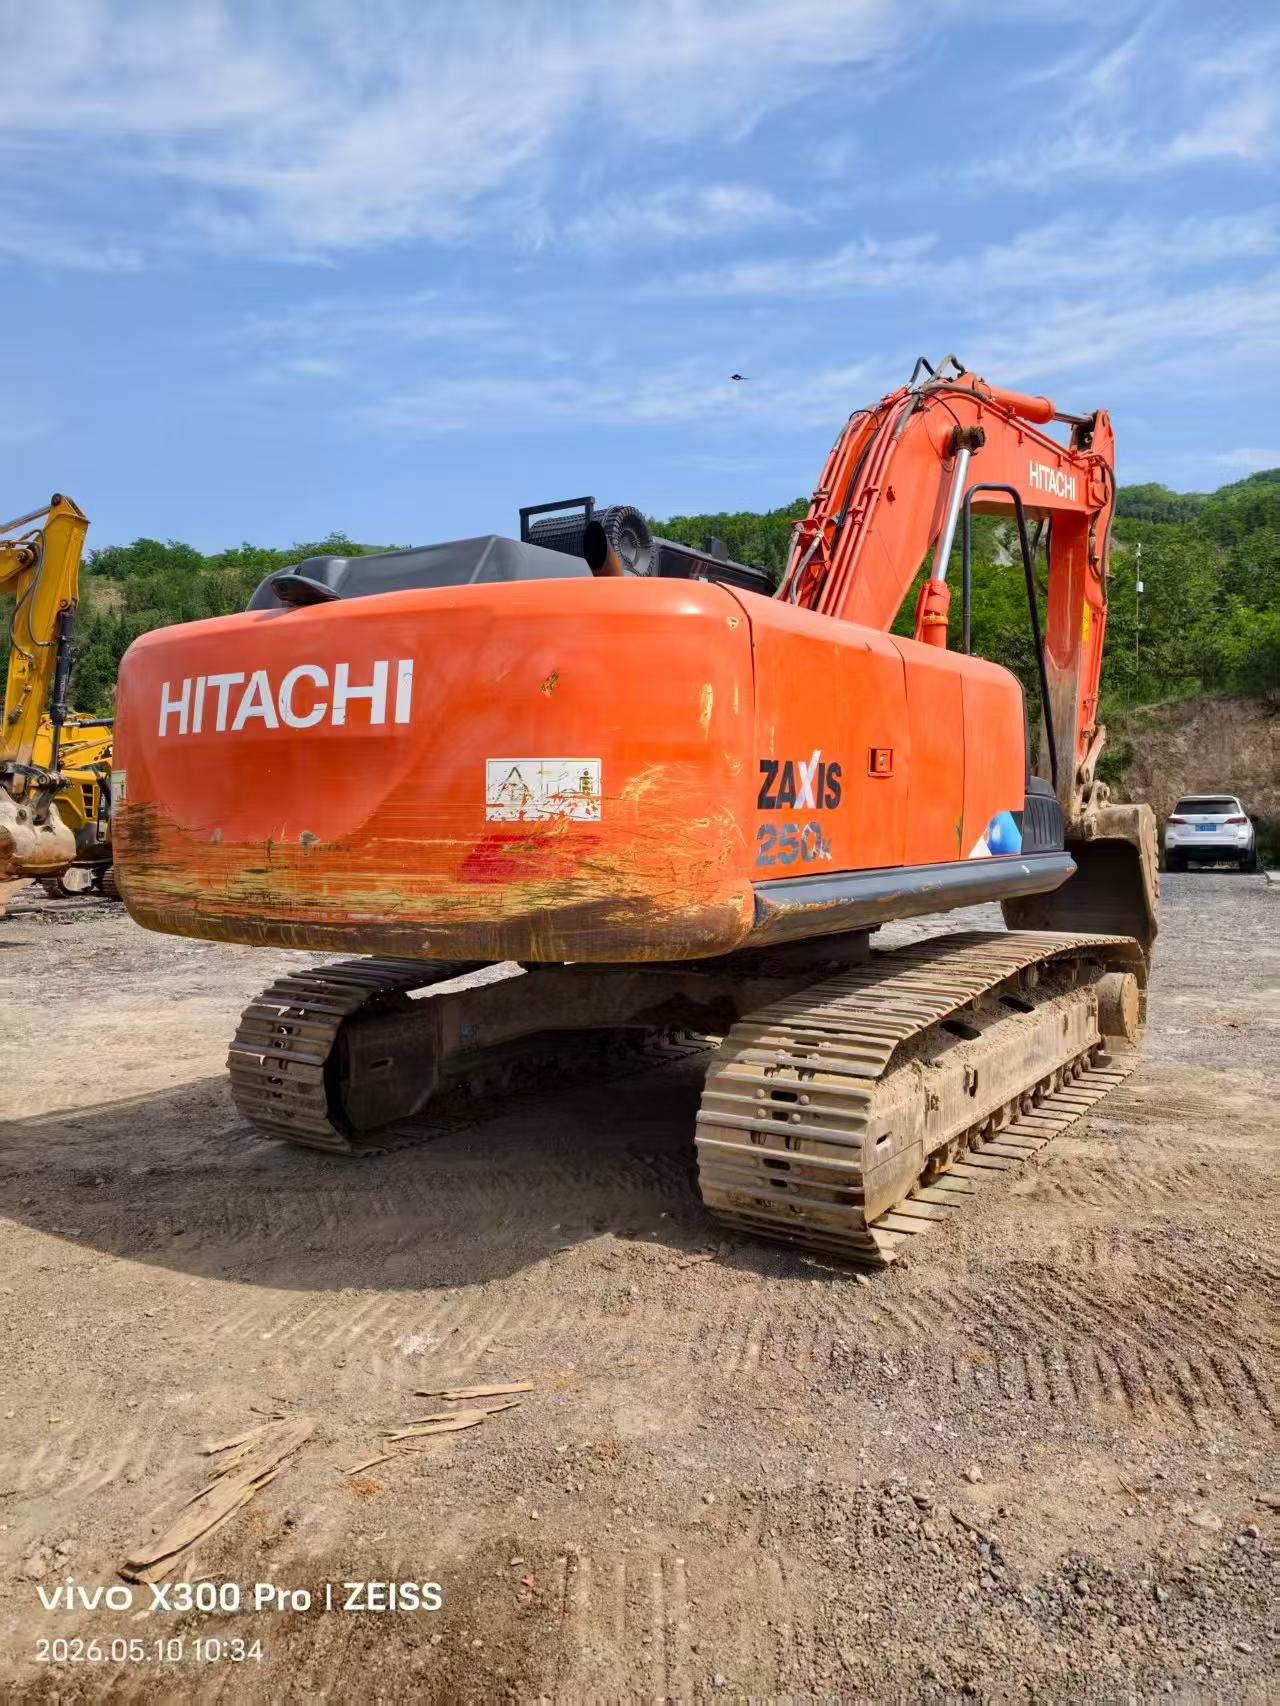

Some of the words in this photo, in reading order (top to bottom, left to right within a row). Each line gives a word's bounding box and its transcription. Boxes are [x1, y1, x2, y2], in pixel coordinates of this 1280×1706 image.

[1029, 460, 1076, 501] HITACHI
[158, 659, 414, 736] HITACHI
[757, 749, 842, 810] ZAXIS
